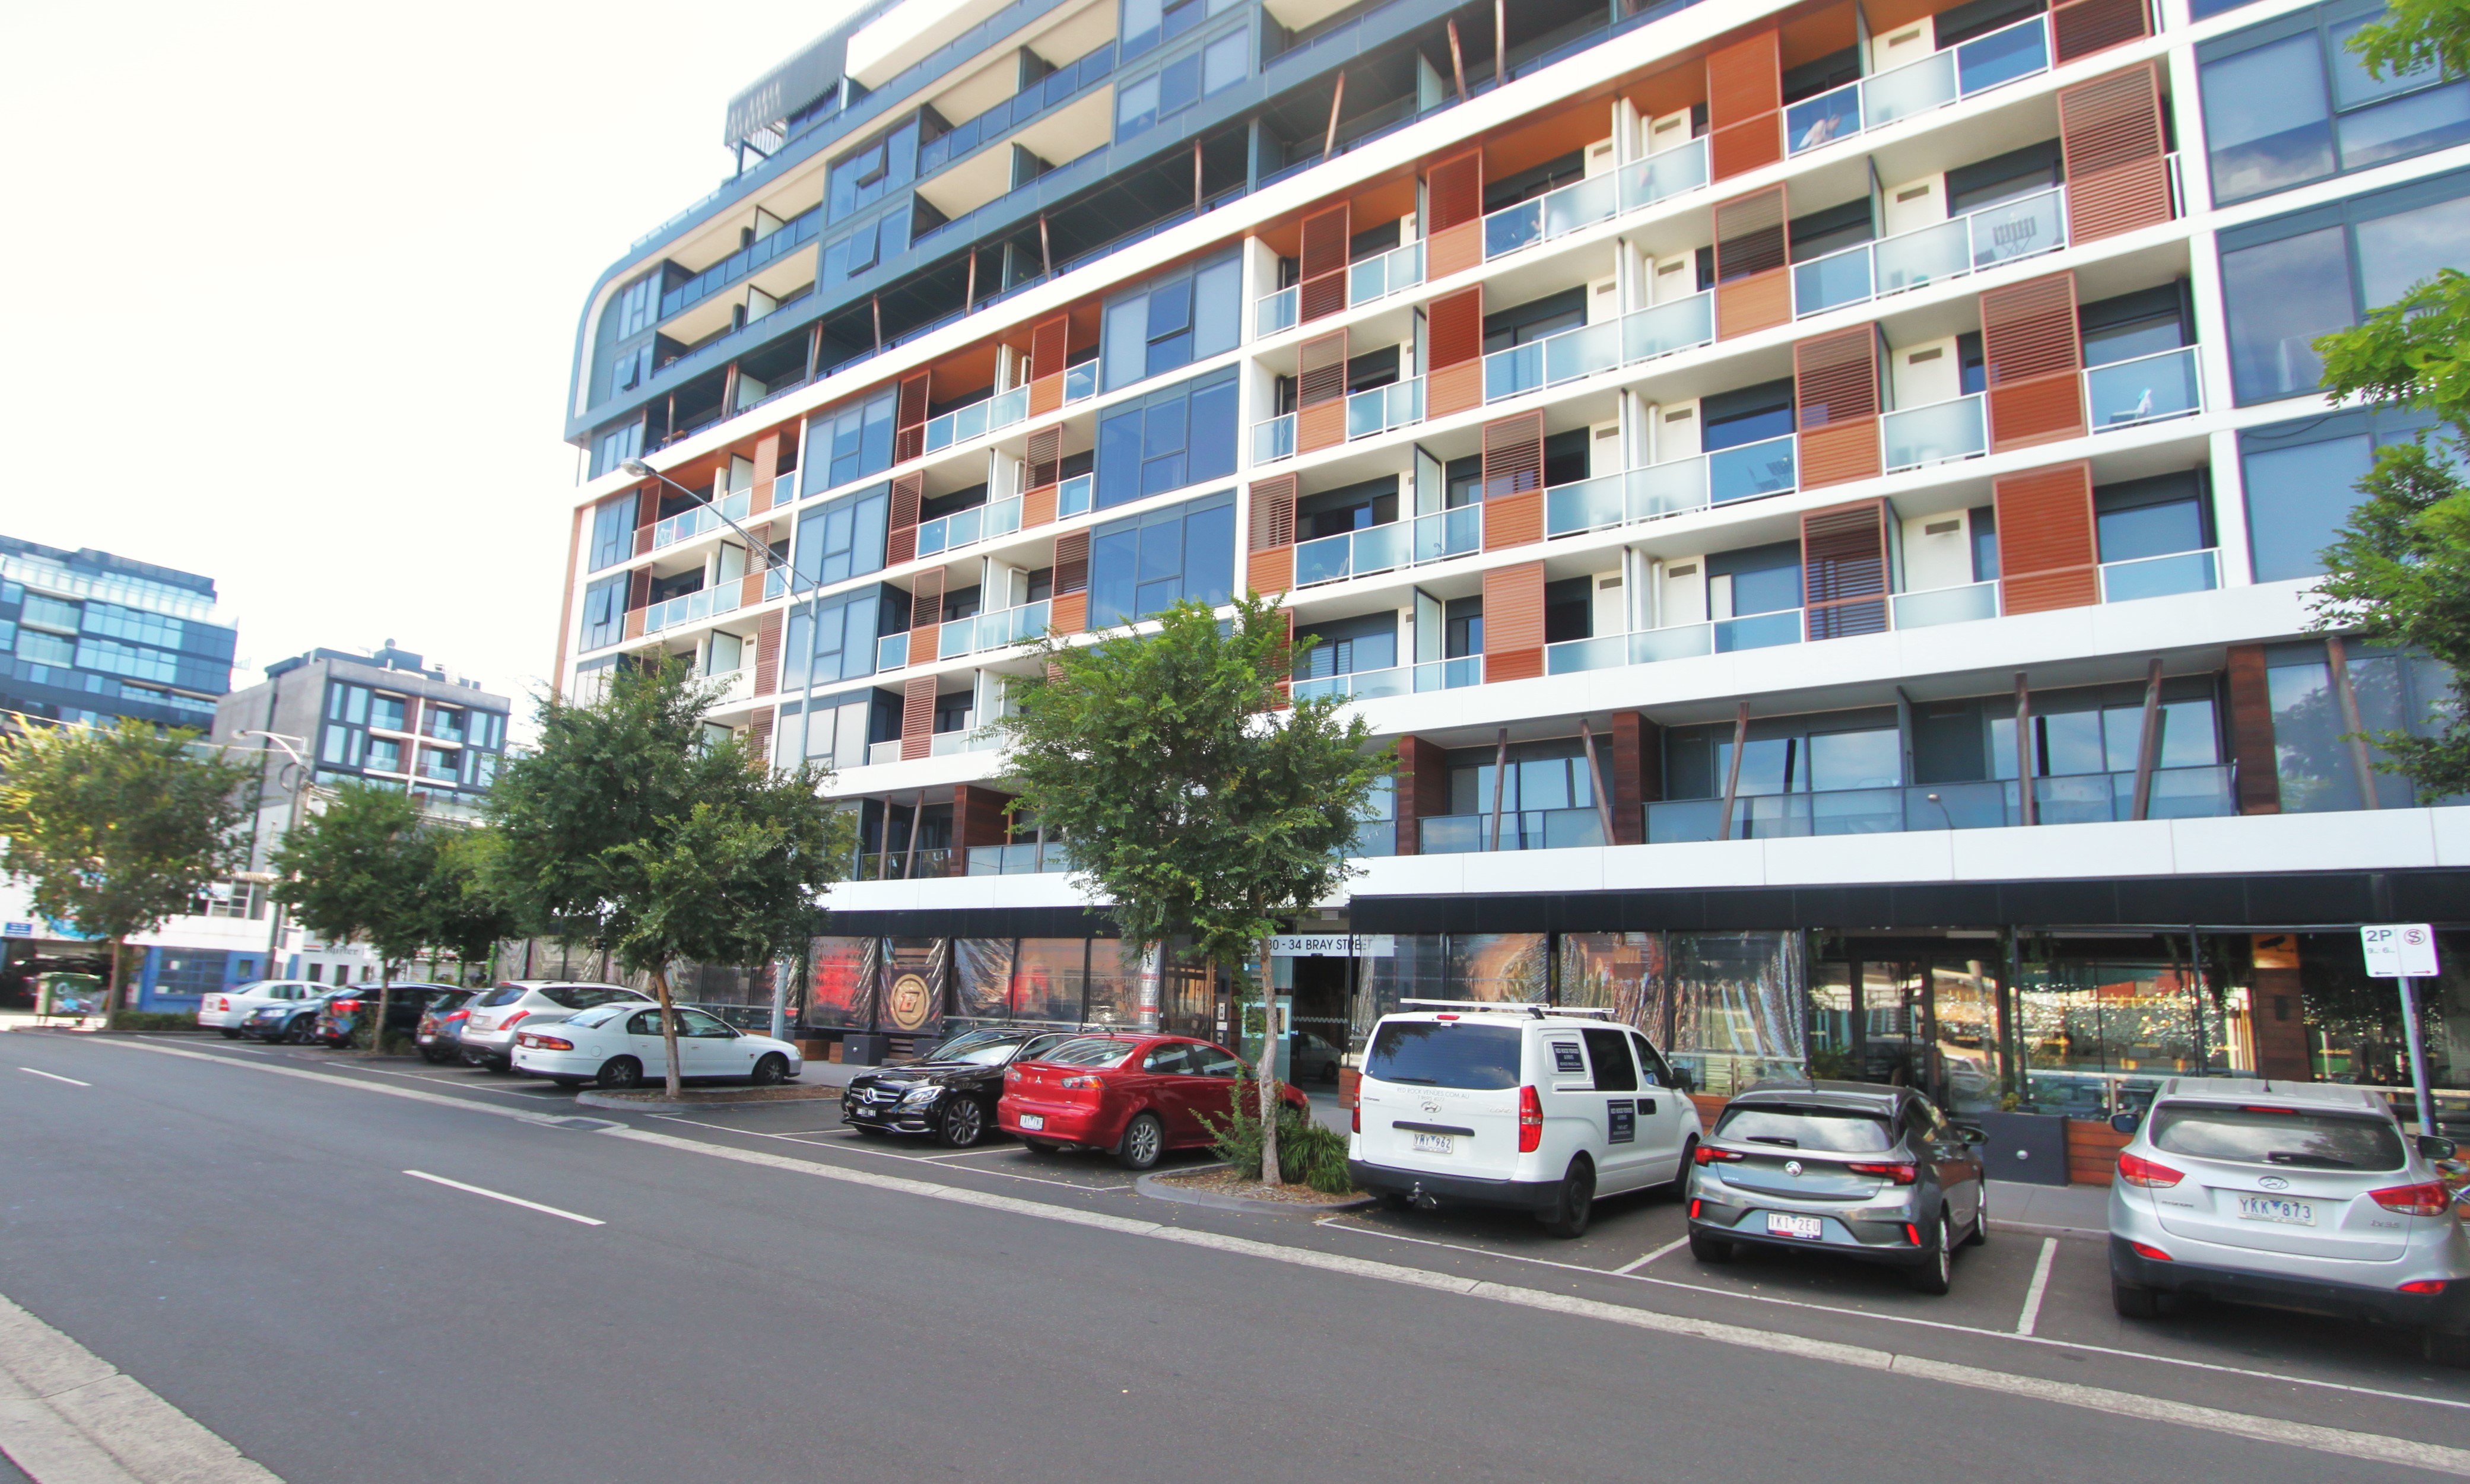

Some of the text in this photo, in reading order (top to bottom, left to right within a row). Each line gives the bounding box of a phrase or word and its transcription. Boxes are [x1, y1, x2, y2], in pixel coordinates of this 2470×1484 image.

[2366, 930, 2392, 942] 2P
[1288, 939, 1301, 950] 34
[1306, 939, 1333, 950] BRAY
[2240, 1198, 2269, 1215] YKK
[2282, 1203, 2311, 1219] 873
